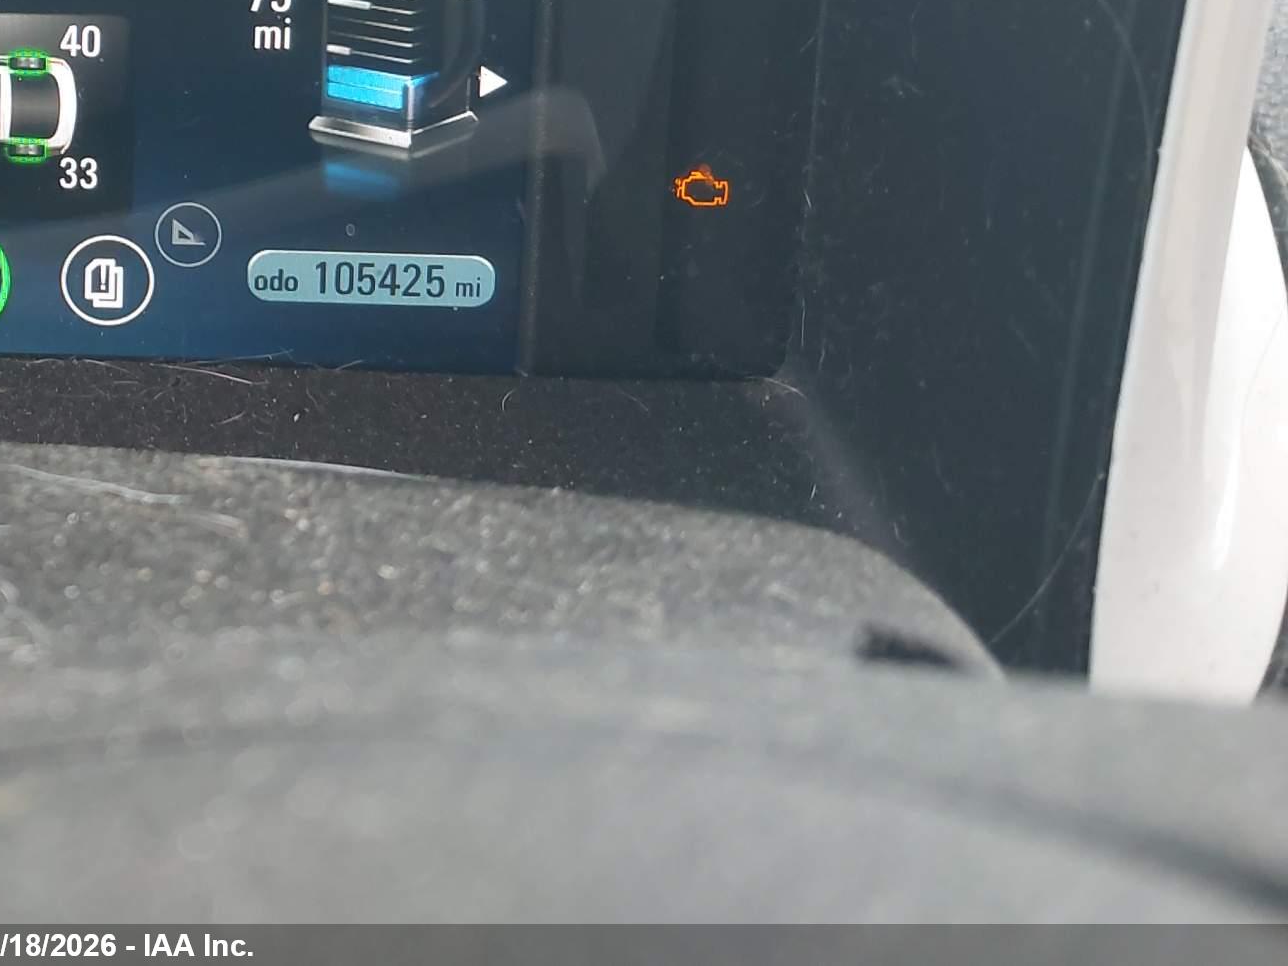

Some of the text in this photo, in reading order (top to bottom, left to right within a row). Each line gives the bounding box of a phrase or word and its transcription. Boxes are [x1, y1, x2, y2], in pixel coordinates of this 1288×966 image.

[60, 25, 101, 57] 40
[254, 18, 291, 49] mi
[59, 157, 98, 189] 33
[254, 261, 481, 298] odo 105425 mi
